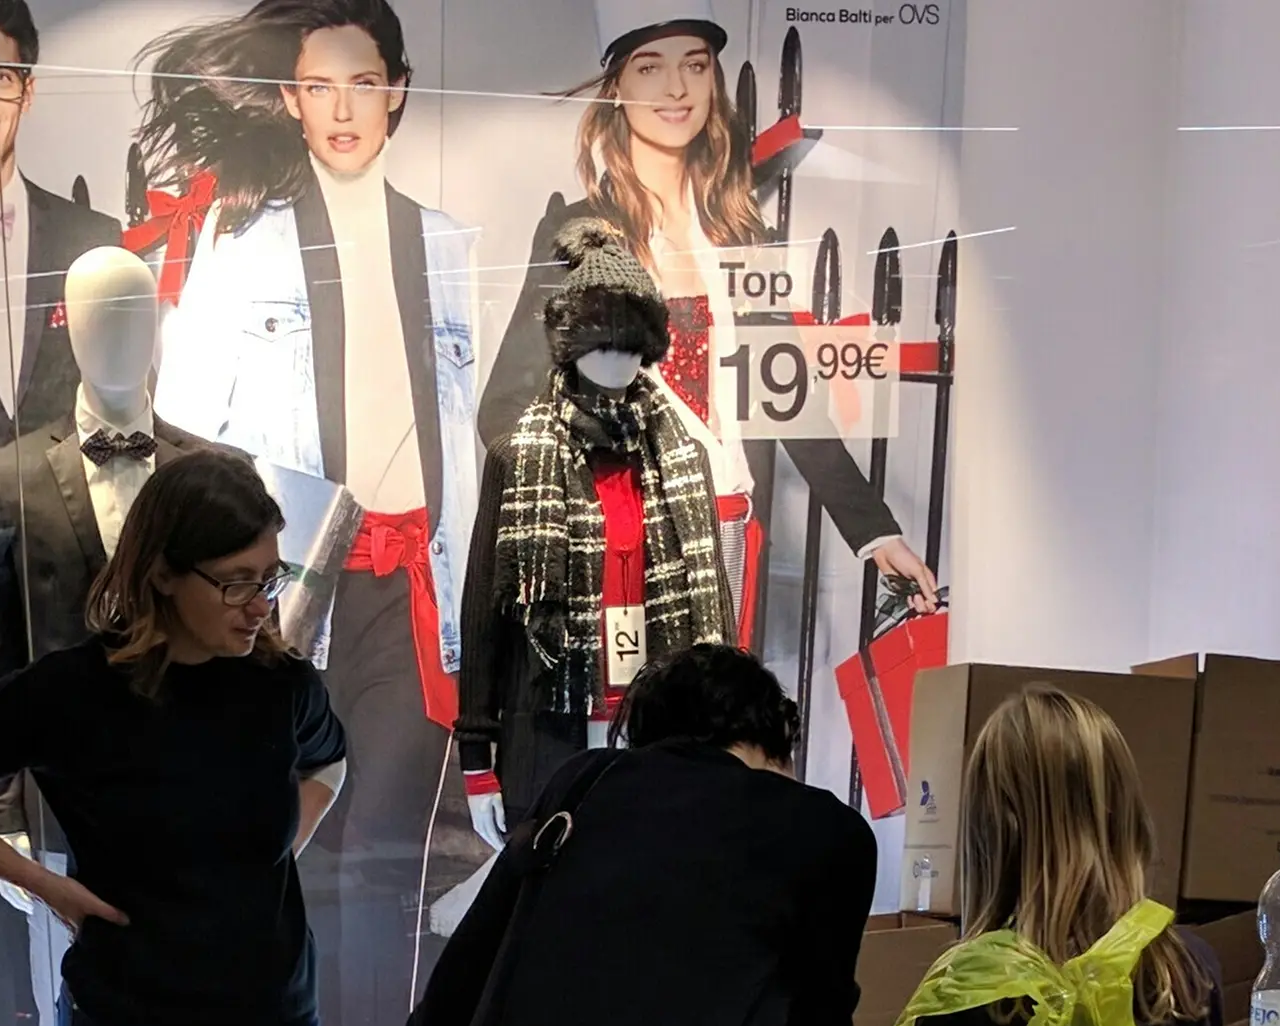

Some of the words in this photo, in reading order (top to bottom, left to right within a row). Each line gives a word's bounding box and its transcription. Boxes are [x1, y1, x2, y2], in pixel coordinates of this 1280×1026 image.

[786, 7, 835, 22] Bianca
[839, 9, 871, 23] Balti
[875, 15, 894, 26] per
[899, 3, 939, 24] OVS
[720, 262, 793, 306] Top
